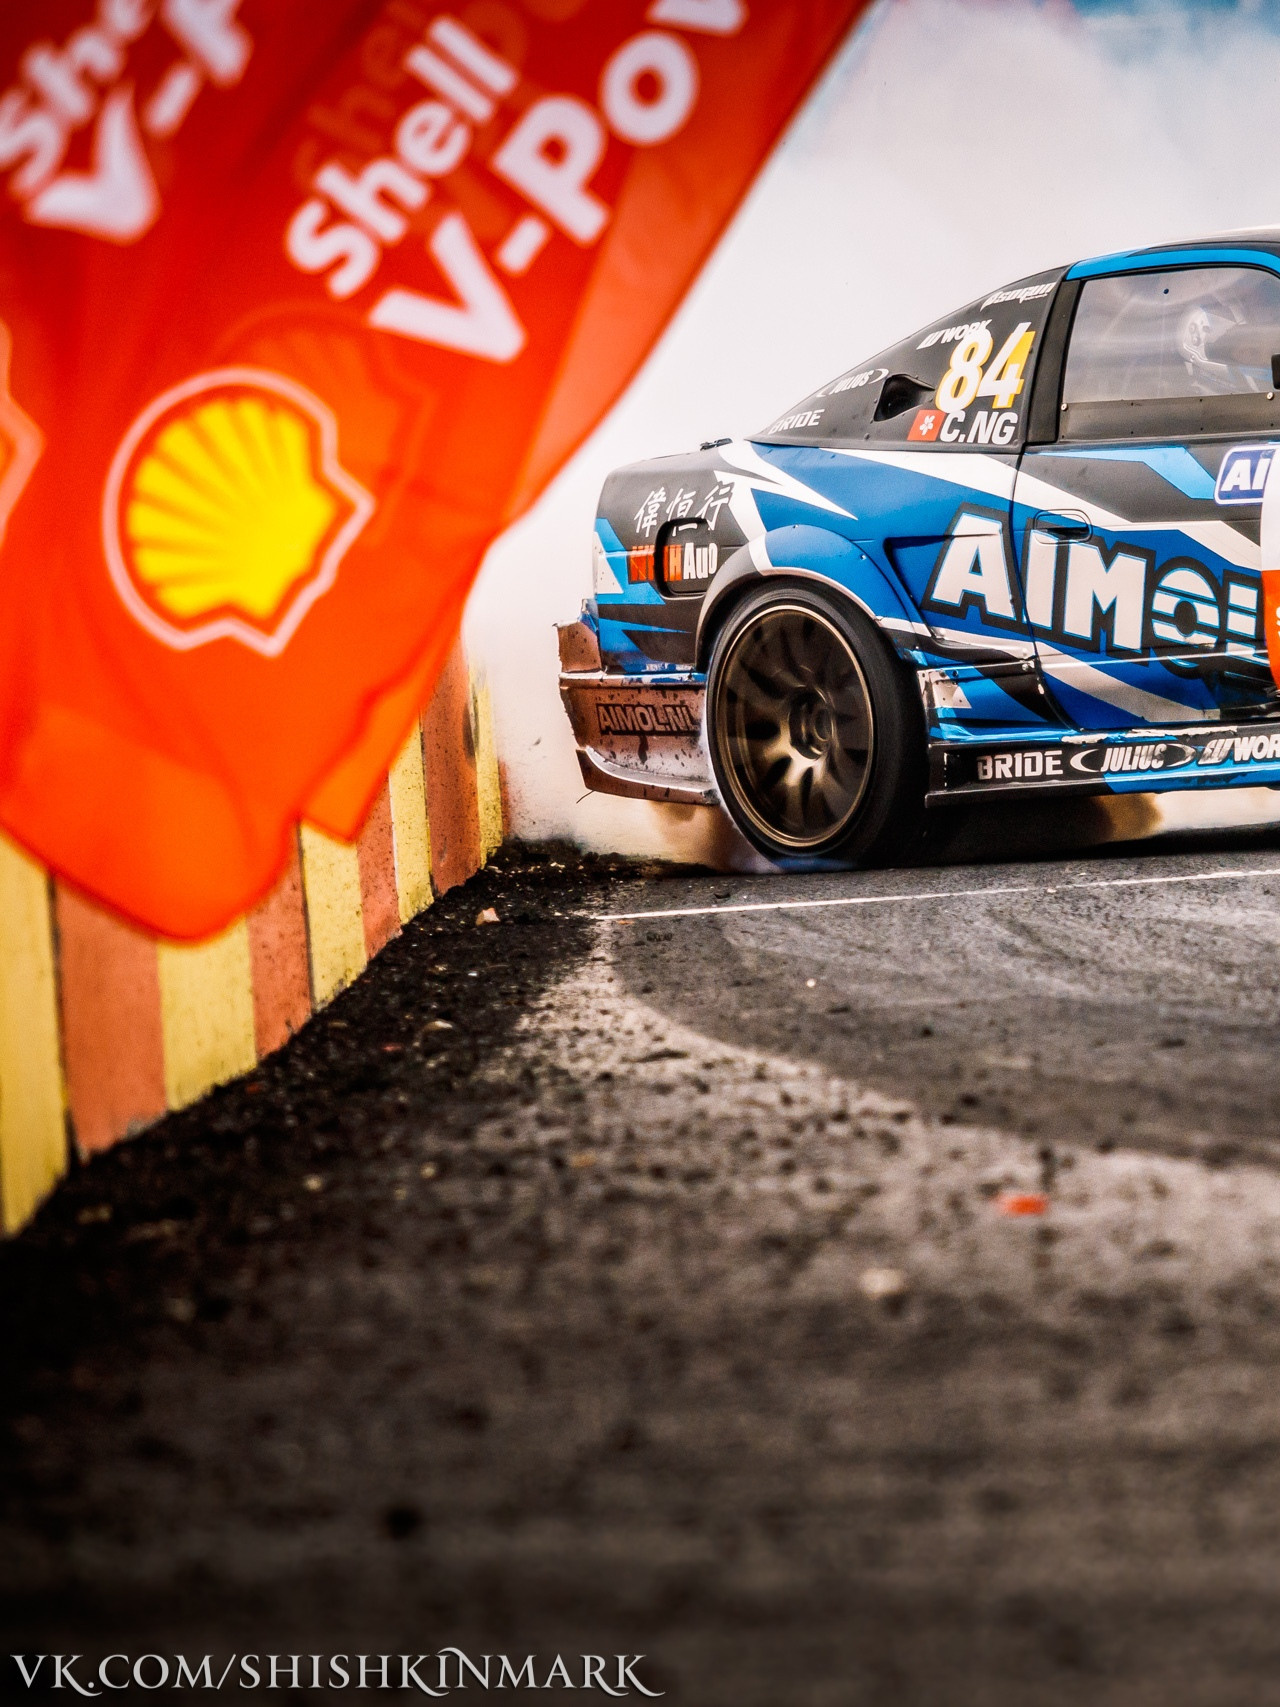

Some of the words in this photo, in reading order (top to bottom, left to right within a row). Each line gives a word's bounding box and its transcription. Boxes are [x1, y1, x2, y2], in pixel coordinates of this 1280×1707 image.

[286, 16, 518, 299] Shell
[935, 322, 1036, 414] 84
[939, 410, 1019, 445] C.NG
[977, 749, 1064, 780] BRIDE
[1100, 742, 1168, 773] JULIUS
